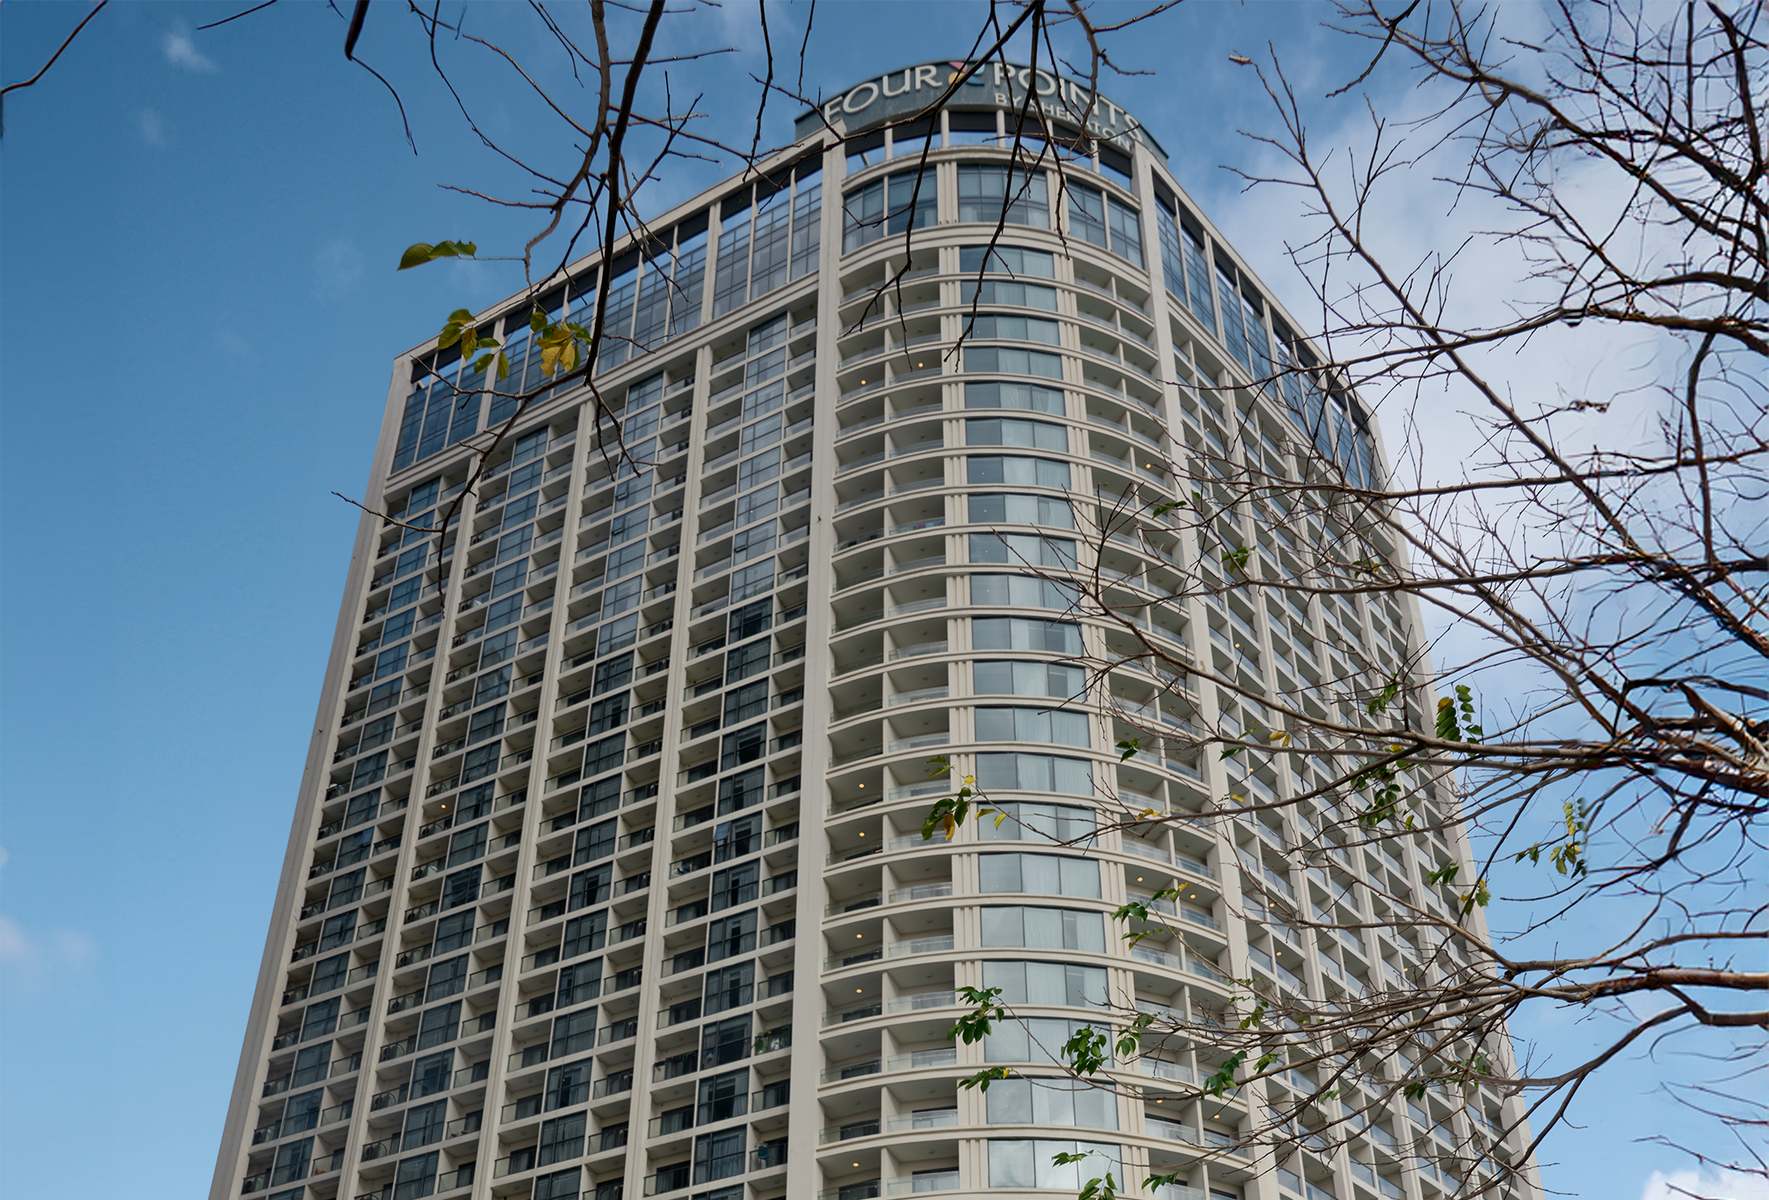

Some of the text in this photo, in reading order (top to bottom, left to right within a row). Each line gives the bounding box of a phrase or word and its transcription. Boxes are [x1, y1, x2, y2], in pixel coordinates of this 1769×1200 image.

[824, 62, 1142, 143] FOUR POINTS
[995, 92, 1022, 107] BY
